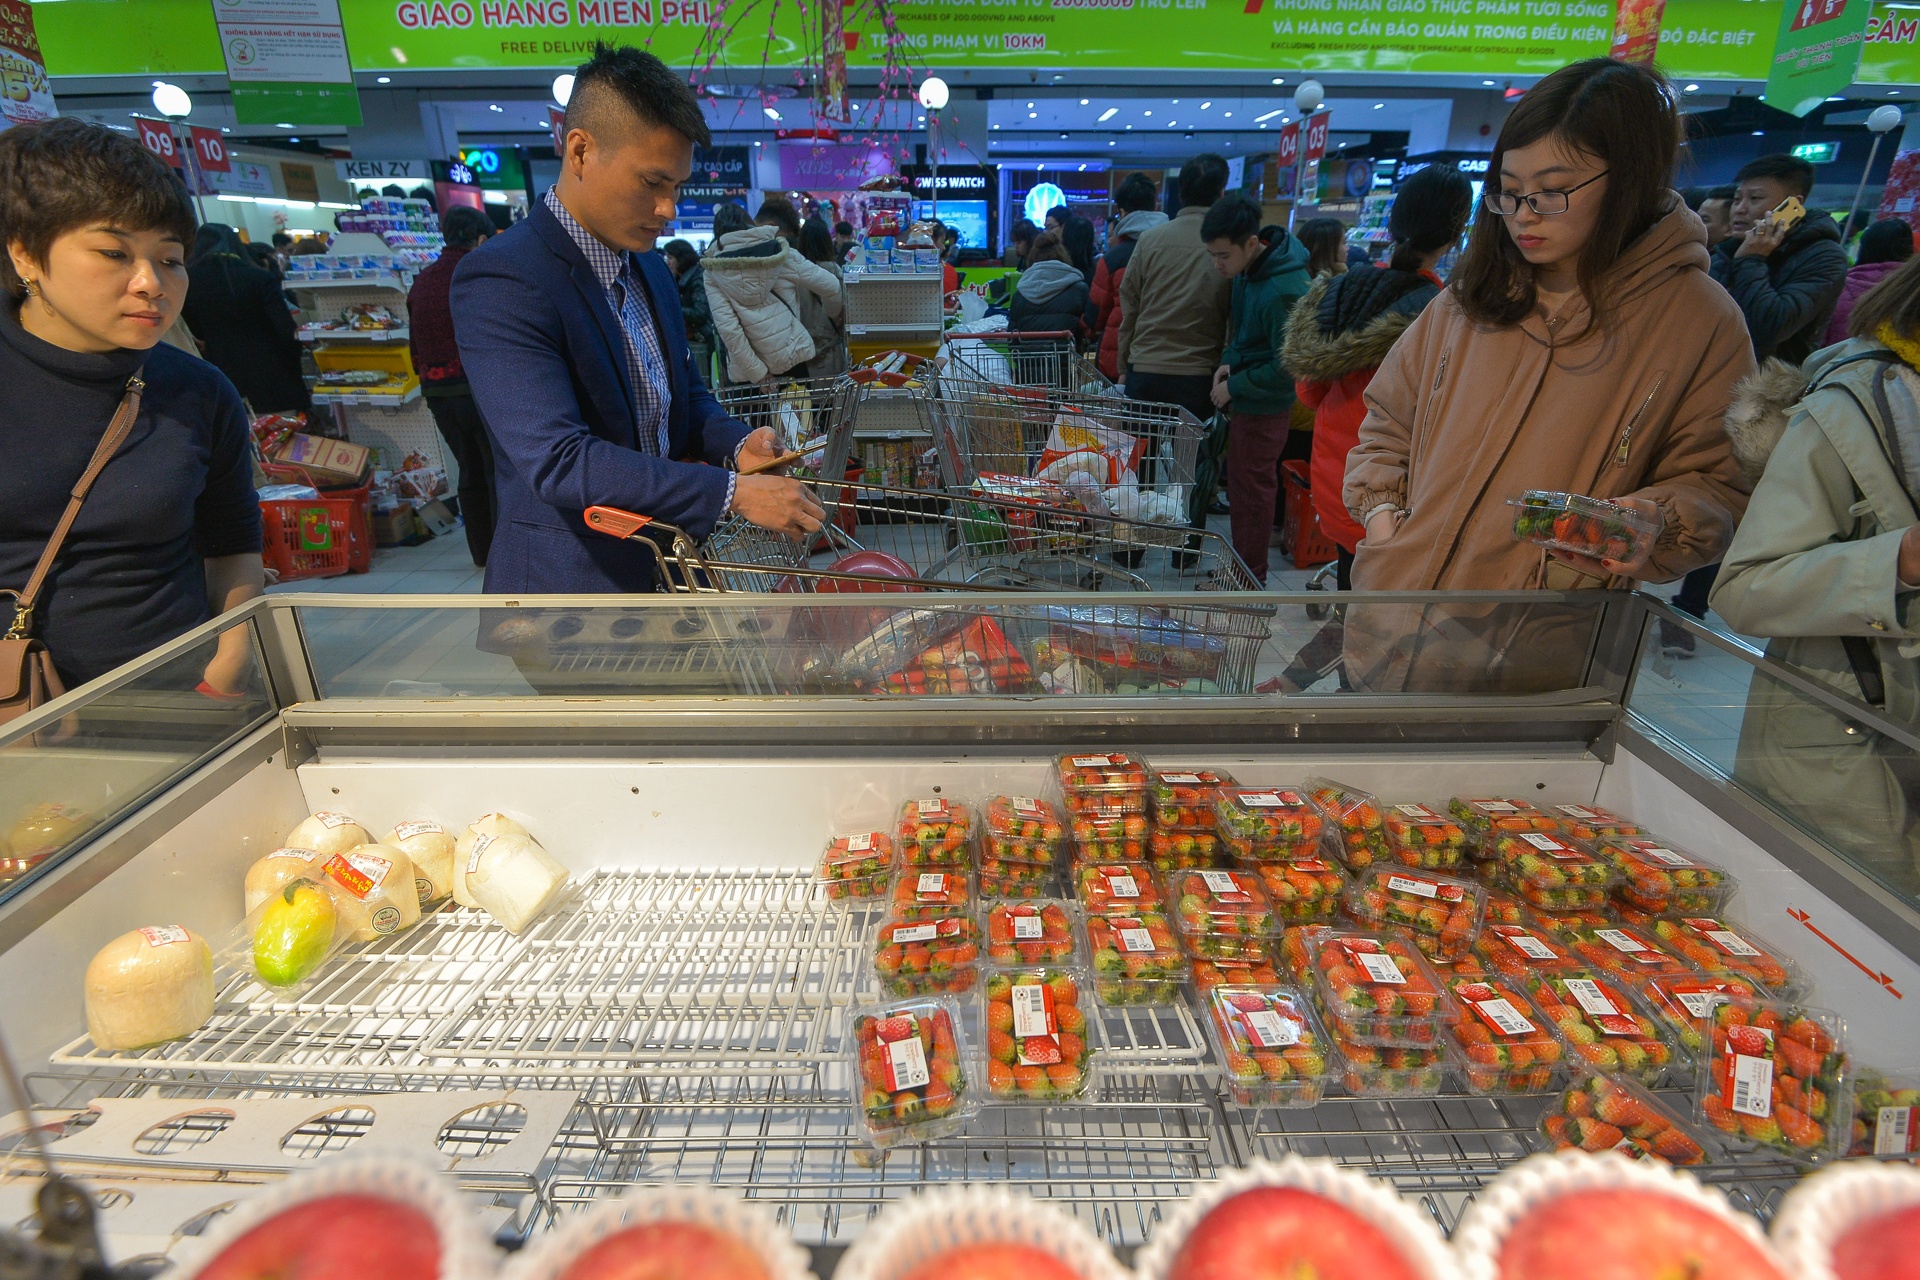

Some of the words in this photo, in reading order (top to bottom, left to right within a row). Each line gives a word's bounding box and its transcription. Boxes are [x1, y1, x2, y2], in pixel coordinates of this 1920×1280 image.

[1386, 0, 1426, 12] GIAO
[398, 2, 473, 28] GIAO
[1028, 14, 1056, 22] ABOVE
[1273, 18, 1294, 35] VÀ
[1297, 17, 1344, 36] HÀNG
[1474, 25, 1528, 40] TRONG
[501, 42, 538, 53] FREE
[870, 34, 928, 48] TRNG
[983, 34, 999, 48] VI
[1003, 33, 1045, 49] 10KM
[145, 130, 173, 157] 09
[1282, 133, 1297, 157] 04
[1309, 124, 1325, 150] 03
[200, 138, 223, 162] 10
[346, 162, 383, 176] KEN
[388, 162, 411, 176] ZY
[704, 161, 723, 173] CAO
[949, 177, 985, 188] WATCH
